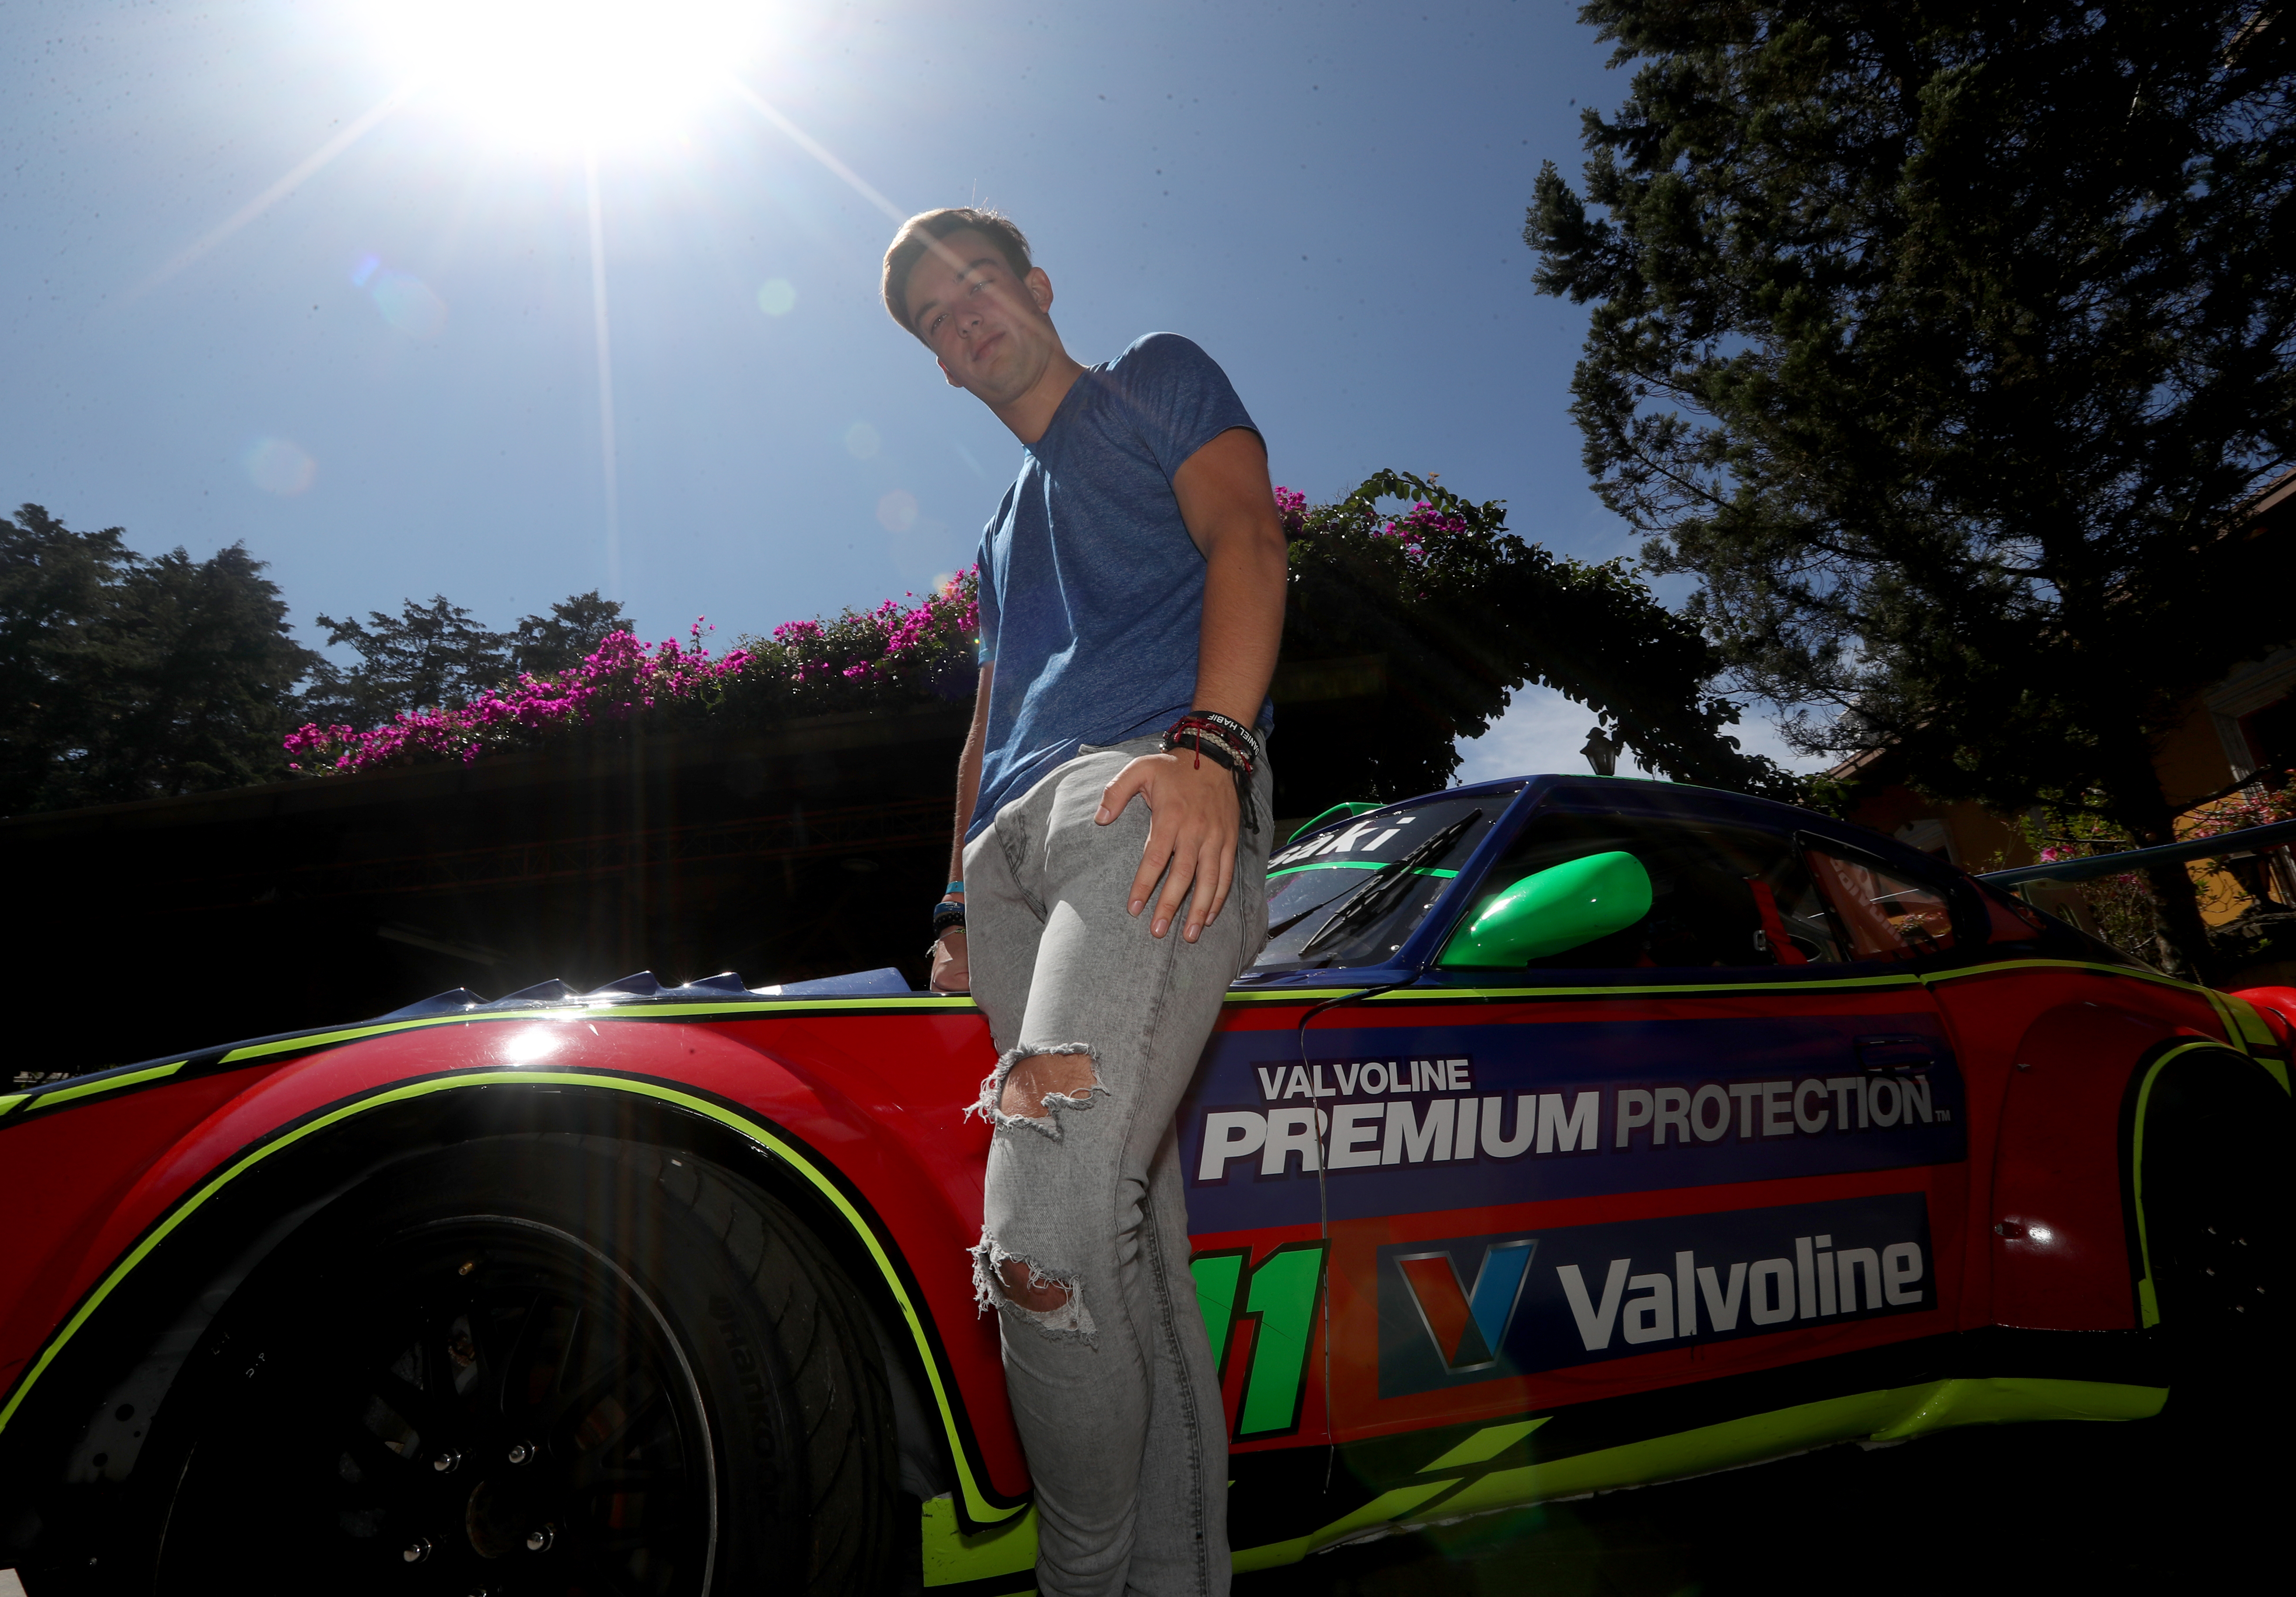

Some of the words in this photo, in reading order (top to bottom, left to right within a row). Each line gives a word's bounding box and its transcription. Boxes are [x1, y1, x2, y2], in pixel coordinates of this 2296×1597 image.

[1207, 714, 1238, 731] HABIF
[1240, 727, 1260, 756] DANIEL
[1257, 1059, 1472, 1100] VALVOLINE
[1198, 1091, 1600, 1183] PREMIUM
[1615, 1075, 1933, 1149] PROTECTION
[1556, 1234, 1924, 1351] Valvoline
